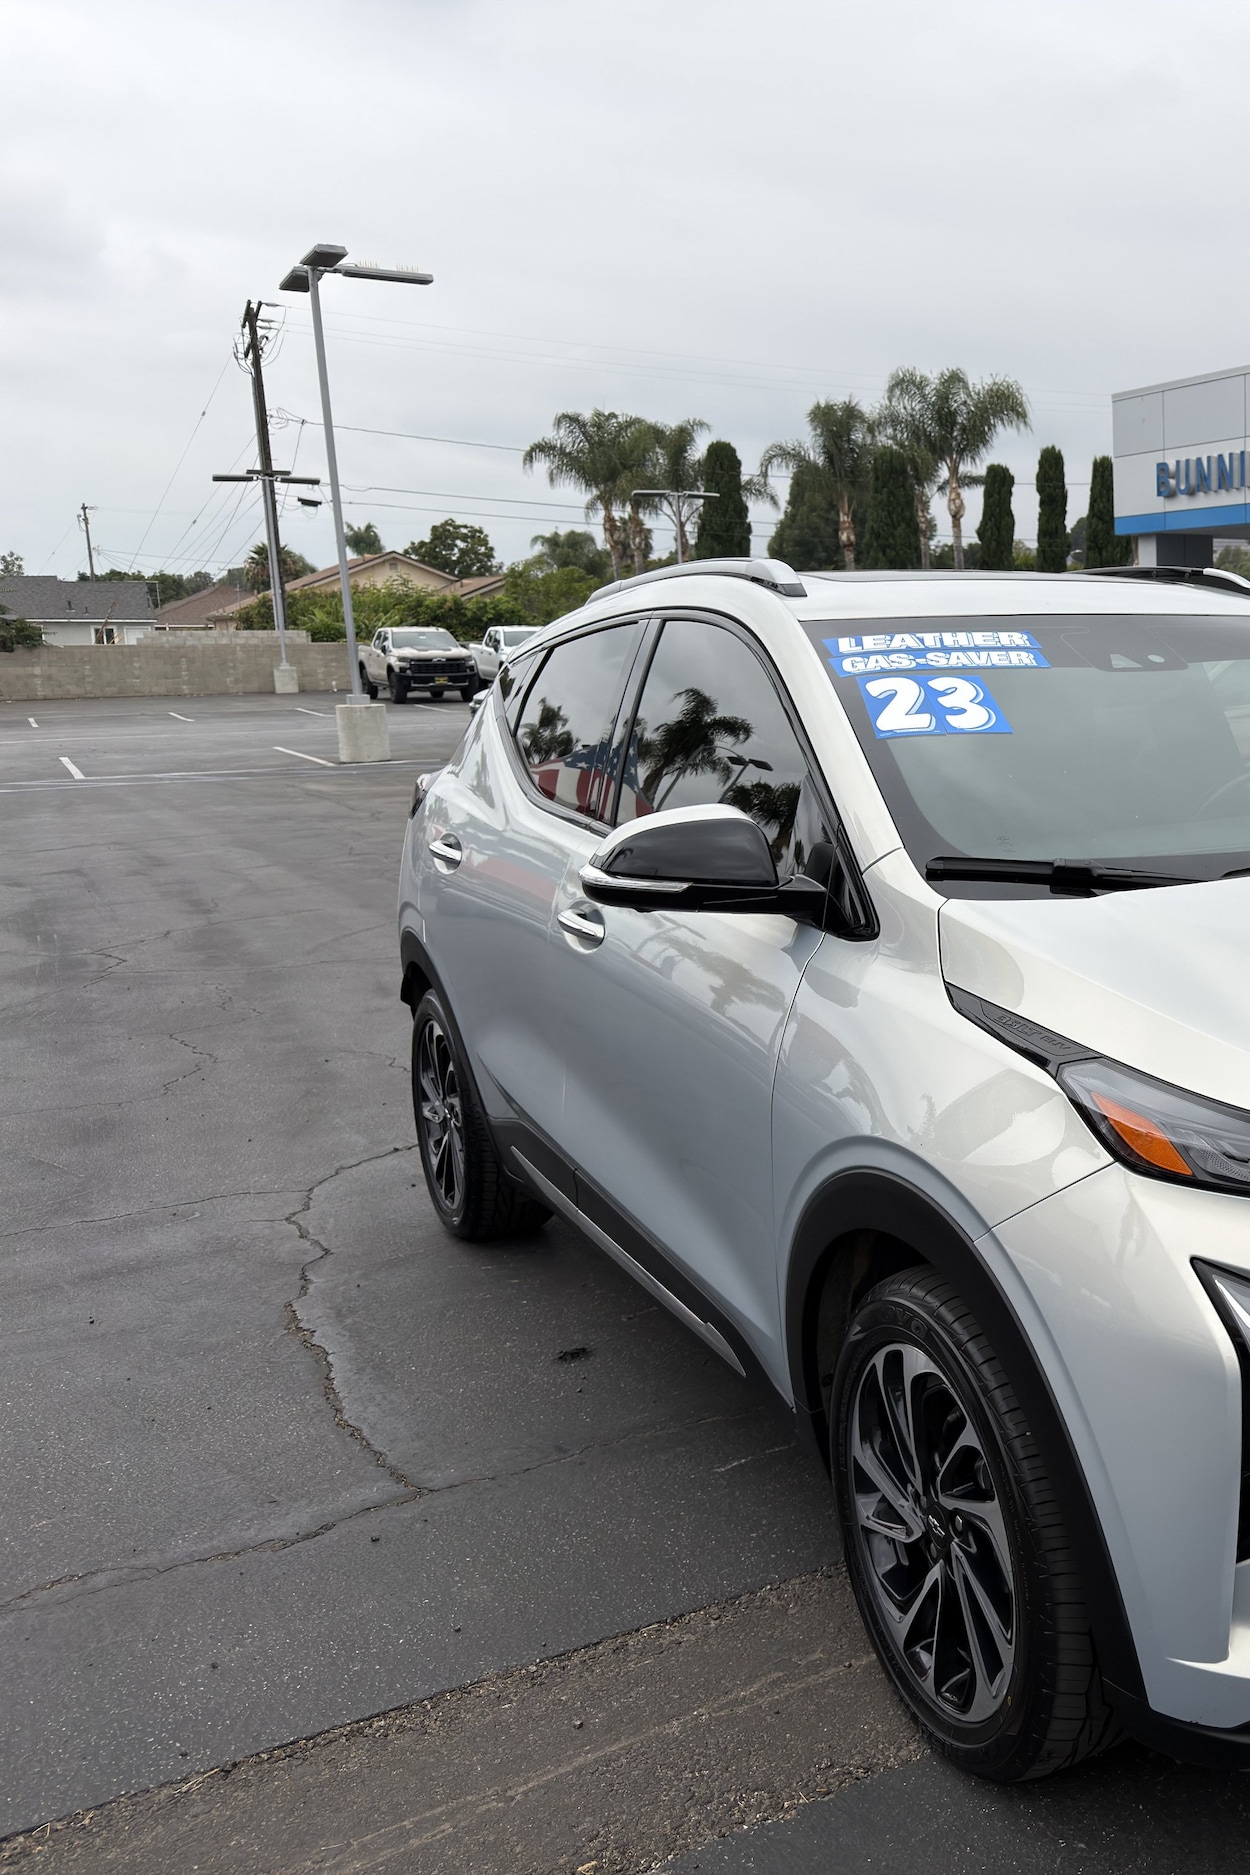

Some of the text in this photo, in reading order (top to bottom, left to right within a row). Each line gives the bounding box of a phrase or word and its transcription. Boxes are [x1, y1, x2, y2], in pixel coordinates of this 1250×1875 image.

[837, 631, 1032, 654] LEATHER
[842, 650, 1038, 674] GAS-SAVER
[864, 676, 996, 733] 23
